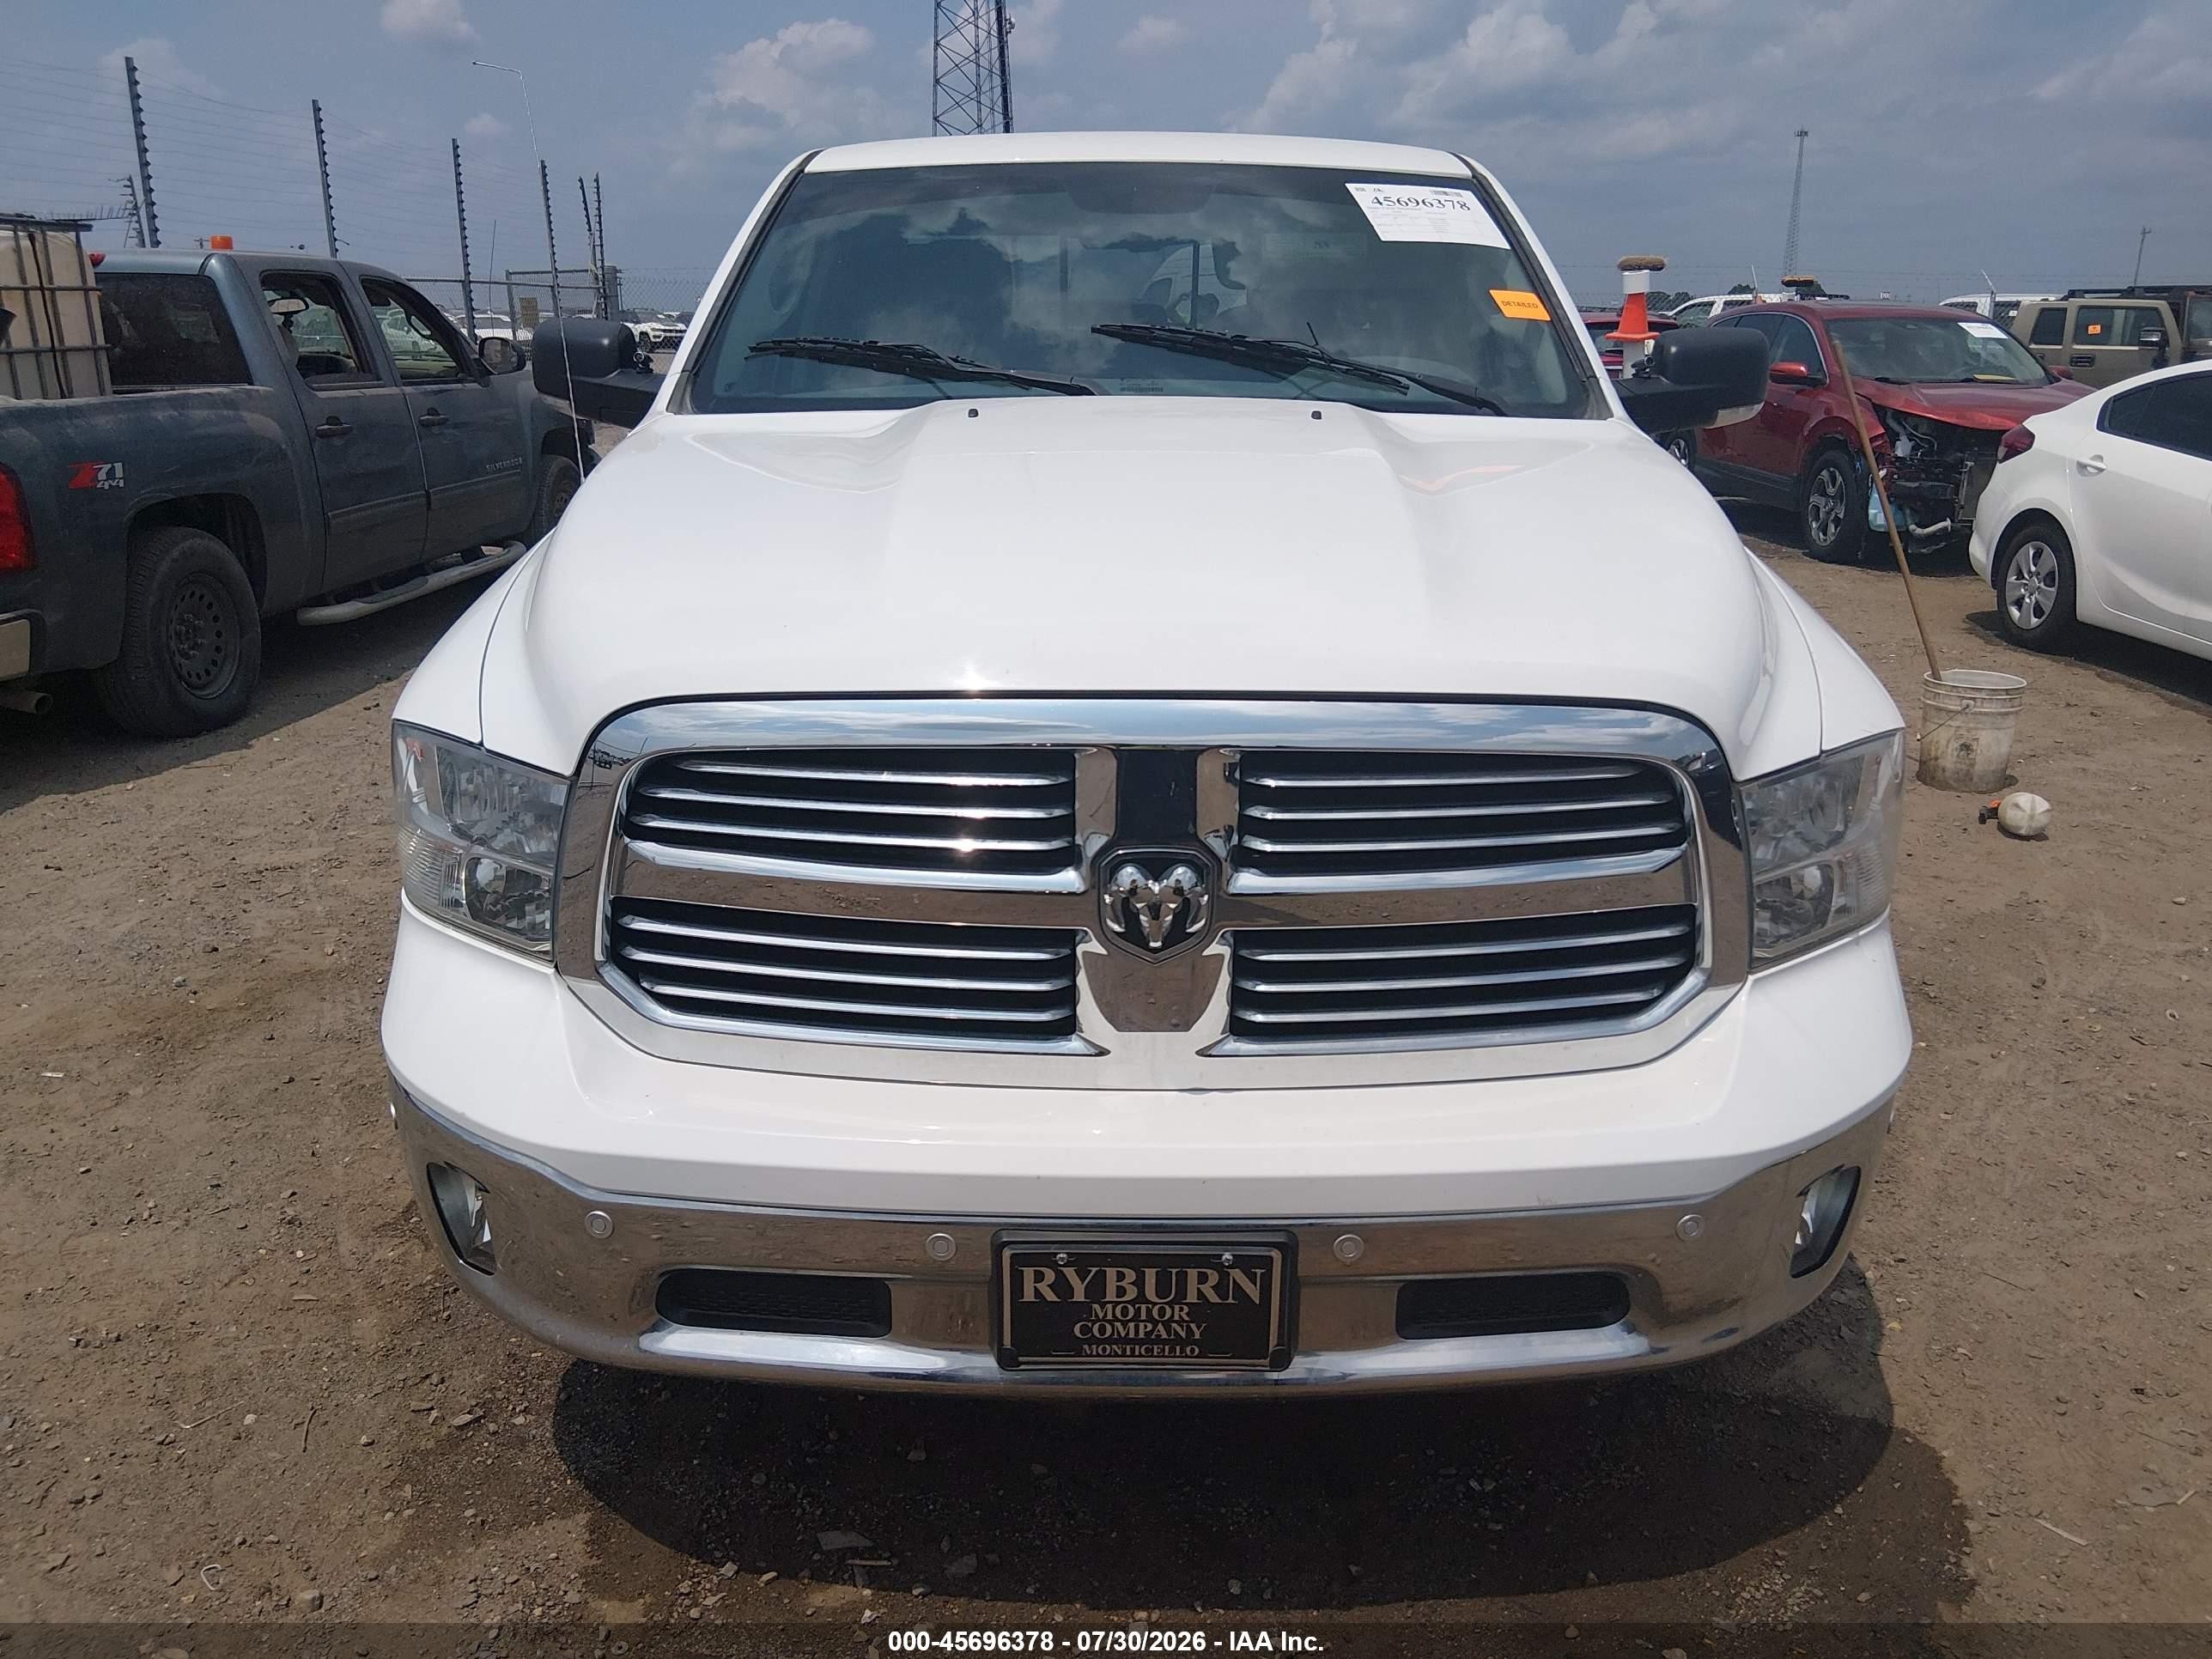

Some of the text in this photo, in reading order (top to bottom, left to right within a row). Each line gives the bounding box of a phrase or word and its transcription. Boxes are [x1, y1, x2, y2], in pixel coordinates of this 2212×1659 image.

[1371, 196, 1471, 211] 45696378
[1501, 301, 1539, 309] DETAILED
[1016, 1266, 1267, 1305] RYBURN
[1090, 1303, 1190, 1321] MOTOR
[1073, 1322, 1207, 1340] COMPANY
[1082, 1344, 1200, 1357] MONTICELLO
